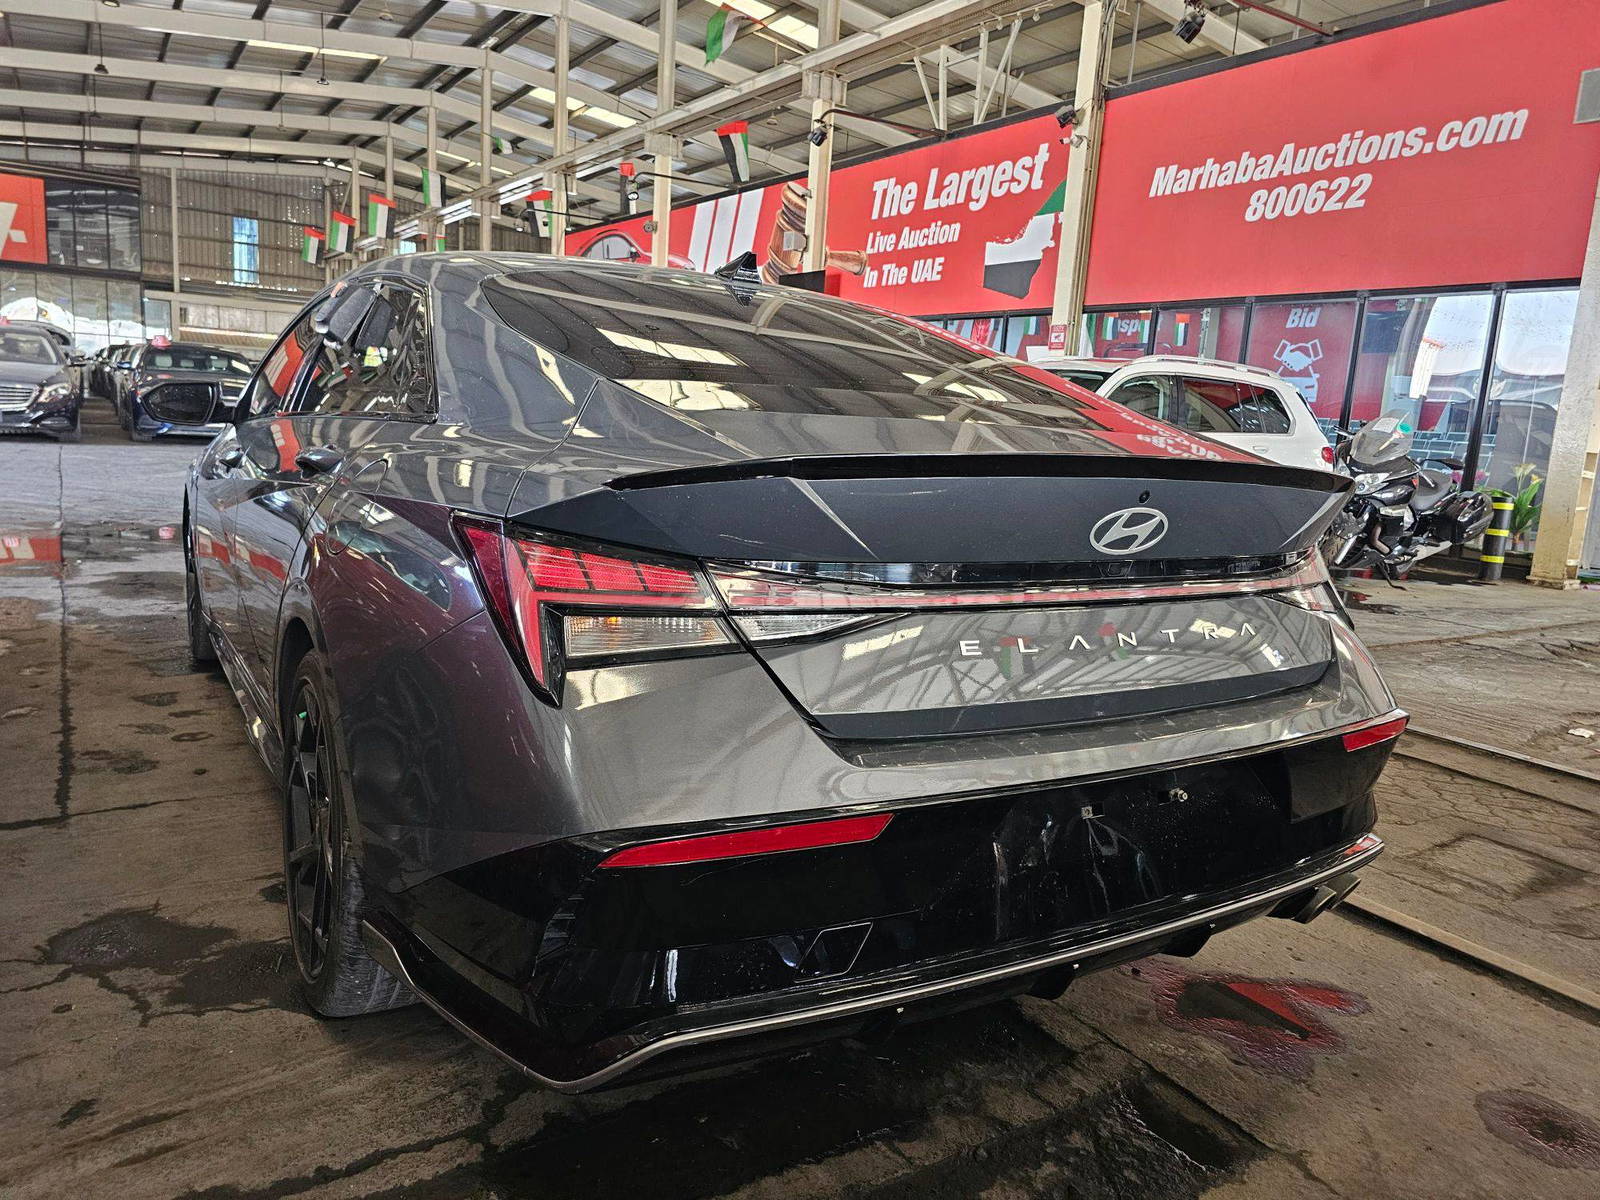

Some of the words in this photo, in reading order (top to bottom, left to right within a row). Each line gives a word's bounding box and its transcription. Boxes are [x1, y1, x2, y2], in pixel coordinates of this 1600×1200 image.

[1149, 108, 1529, 198] MarhabaAuctions.com
[871, 177, 917, 220] The
[923, 143, 1050, 212] Largest
[1244, 173, 1373, 223] 800622
[866, 232, 896, 255] Live
[897, 221, 960, 250] Auction
[863, 267, 878, 289] In
[882, 263, 907, 287] The
[910, 257, 945, 283] UAE
[1285, 307, 1322, 329] Bid
[958, 622, 1257, 656] ELANTRA
